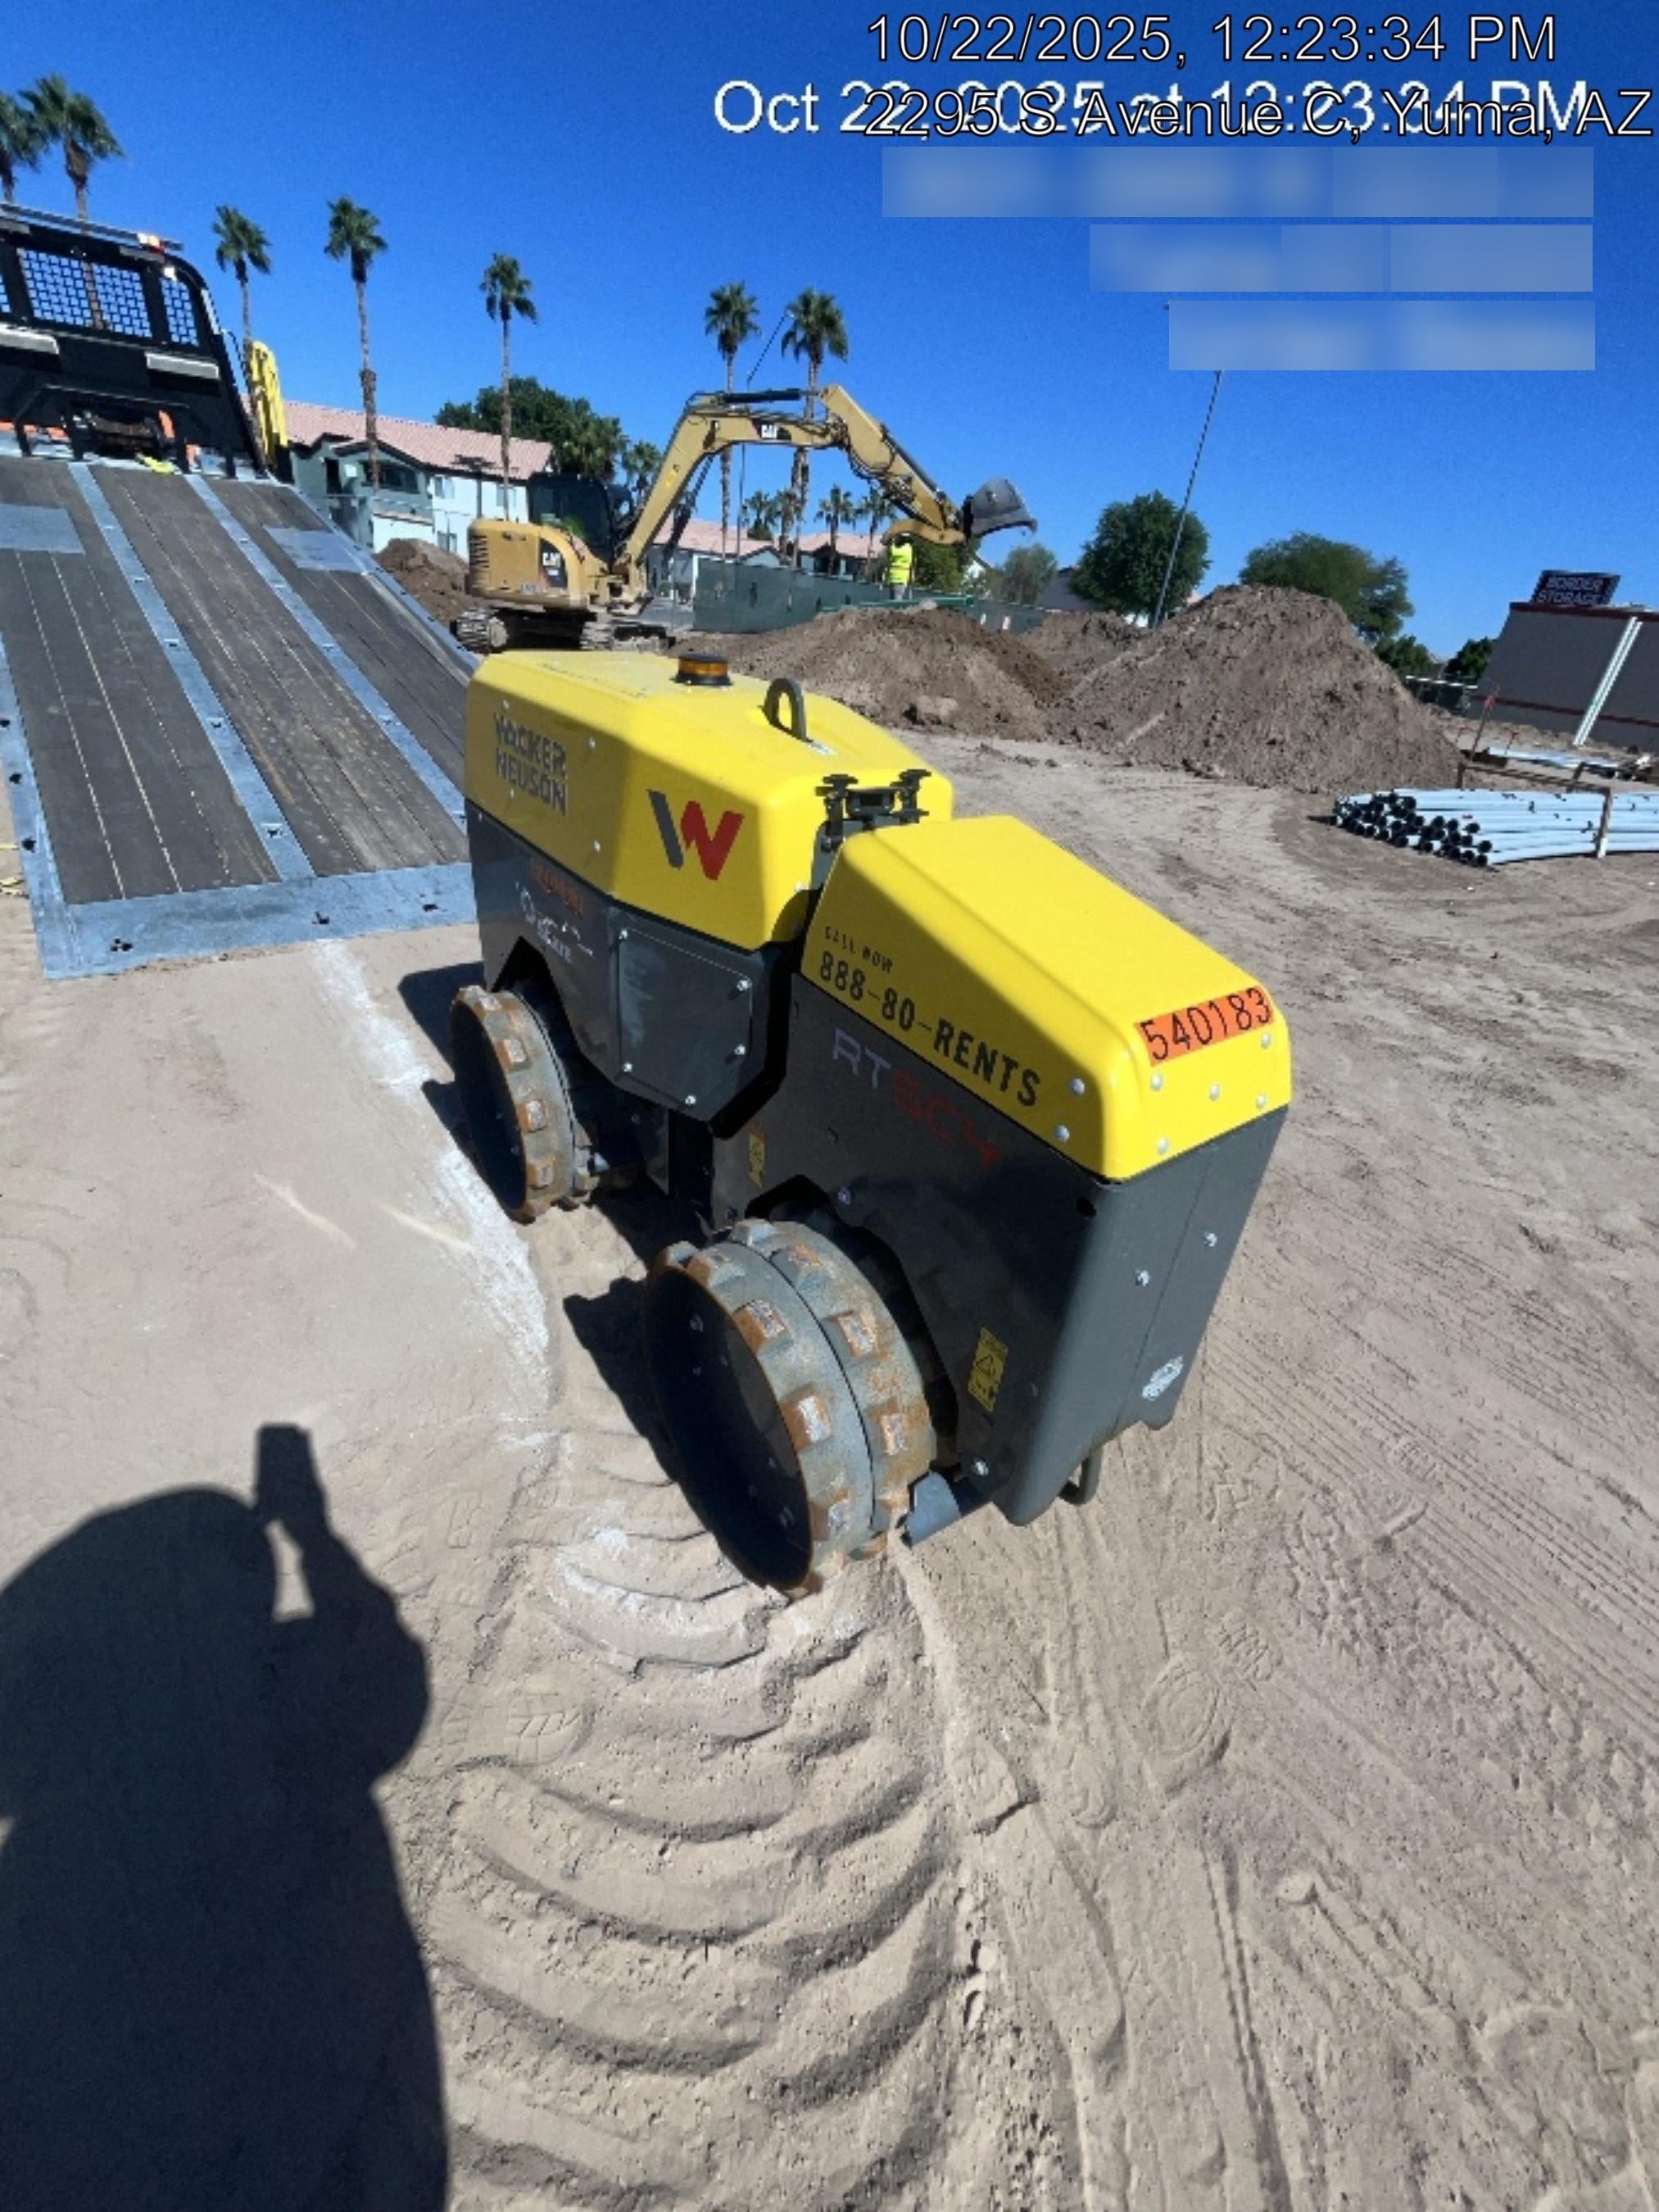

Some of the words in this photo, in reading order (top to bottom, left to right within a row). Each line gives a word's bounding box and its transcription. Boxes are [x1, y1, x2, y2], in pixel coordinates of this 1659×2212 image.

[493, 711, 568, 777] WACKER
[496, 746, 568, 816] NEUSON
[820, 950, 1040, 1107] 888-80-RENTS
[1140, 986, 1271, 1061] 540183
